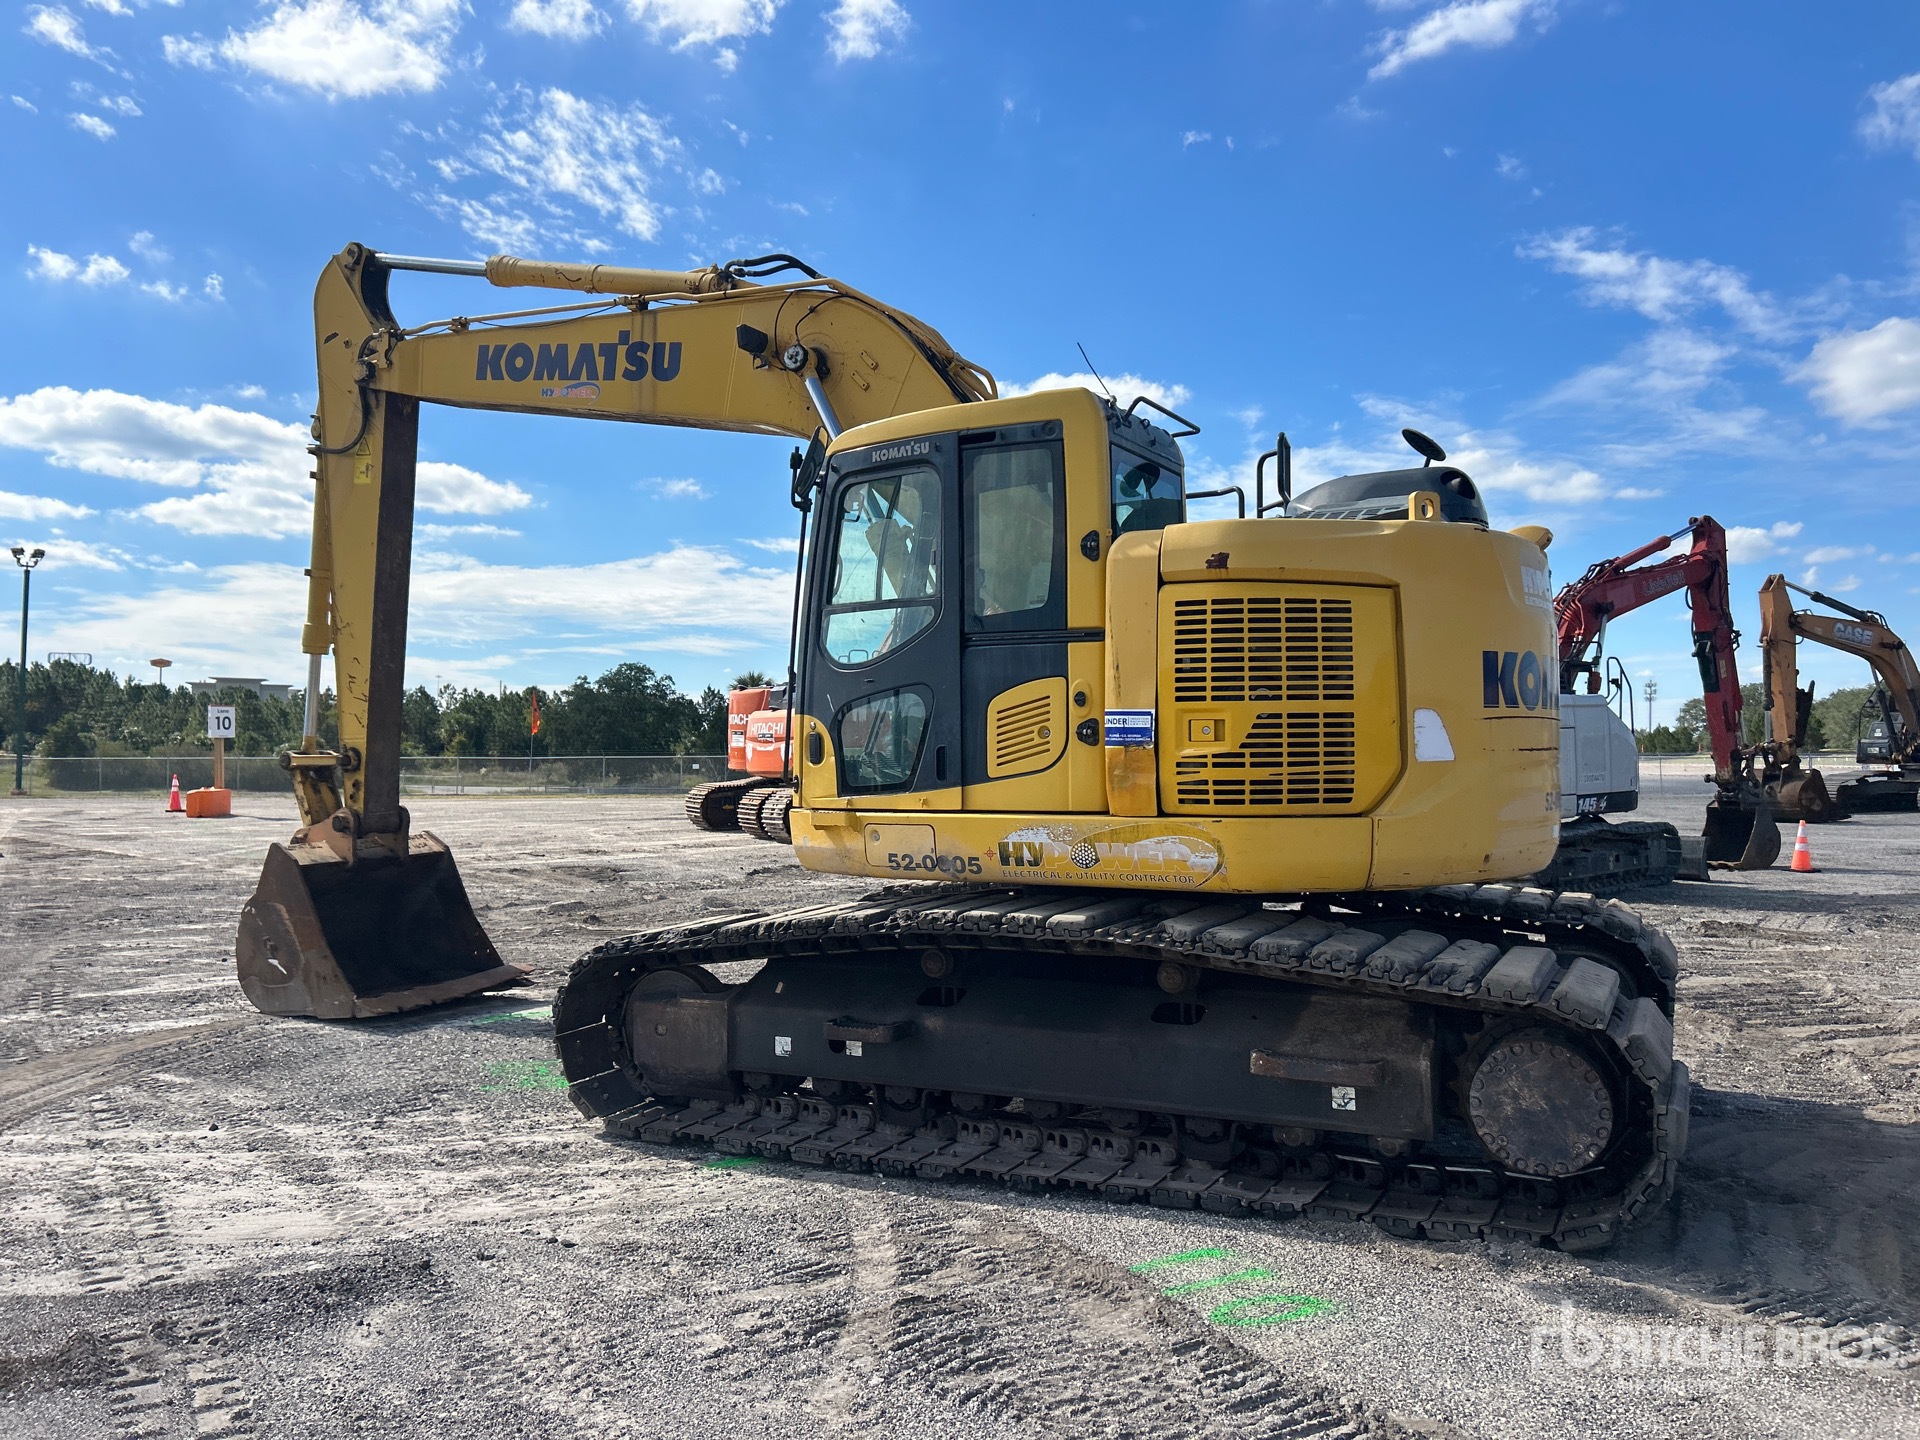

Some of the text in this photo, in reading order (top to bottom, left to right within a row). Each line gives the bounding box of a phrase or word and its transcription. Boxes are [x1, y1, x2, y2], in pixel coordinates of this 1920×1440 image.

[475, 329, 683, 382] KOMATSU
[871, 441, 930, 463] KOMATSU
[1833, 622, 1873, 647] CASE
[215, 716, 232, 730] 10
[751, 722, 784, 735] HITACHI
[1002, 869, 1197, 885] ELECTRICAL & UTILITY CONTRACTOR
